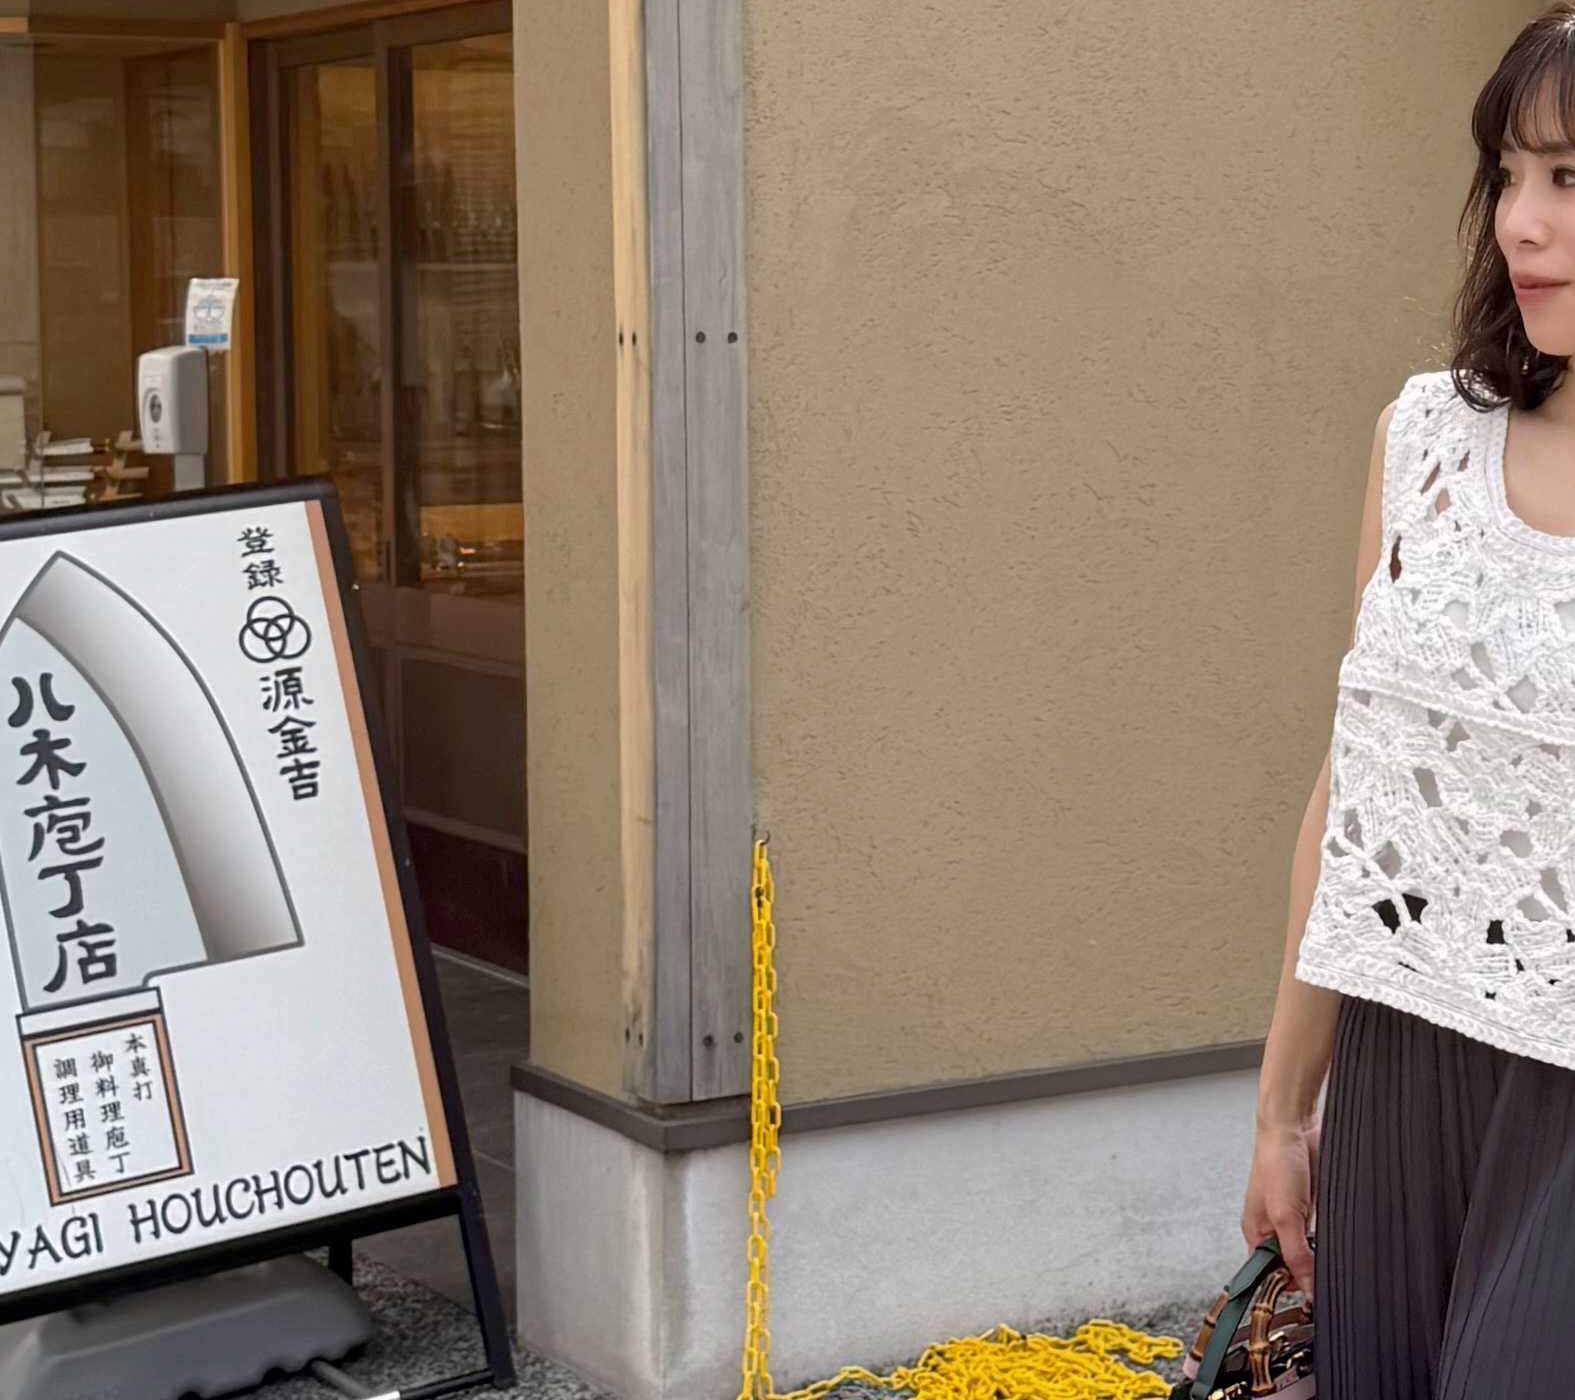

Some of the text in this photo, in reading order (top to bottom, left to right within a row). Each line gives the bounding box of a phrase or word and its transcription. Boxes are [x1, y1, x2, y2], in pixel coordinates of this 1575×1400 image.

[236, 526, 321, 801] 登録 源金吉
[8, 671, 116, 993] 八木庖丁店
[53, 1057, 97, 1183] 調理用道具
[90, 1050, 131, 1174] 御料理庖丁
[124, 1032, 153, 1101] 本真打
[0, 1135, 432, 1276] YAGI HOUCHOUTEN
